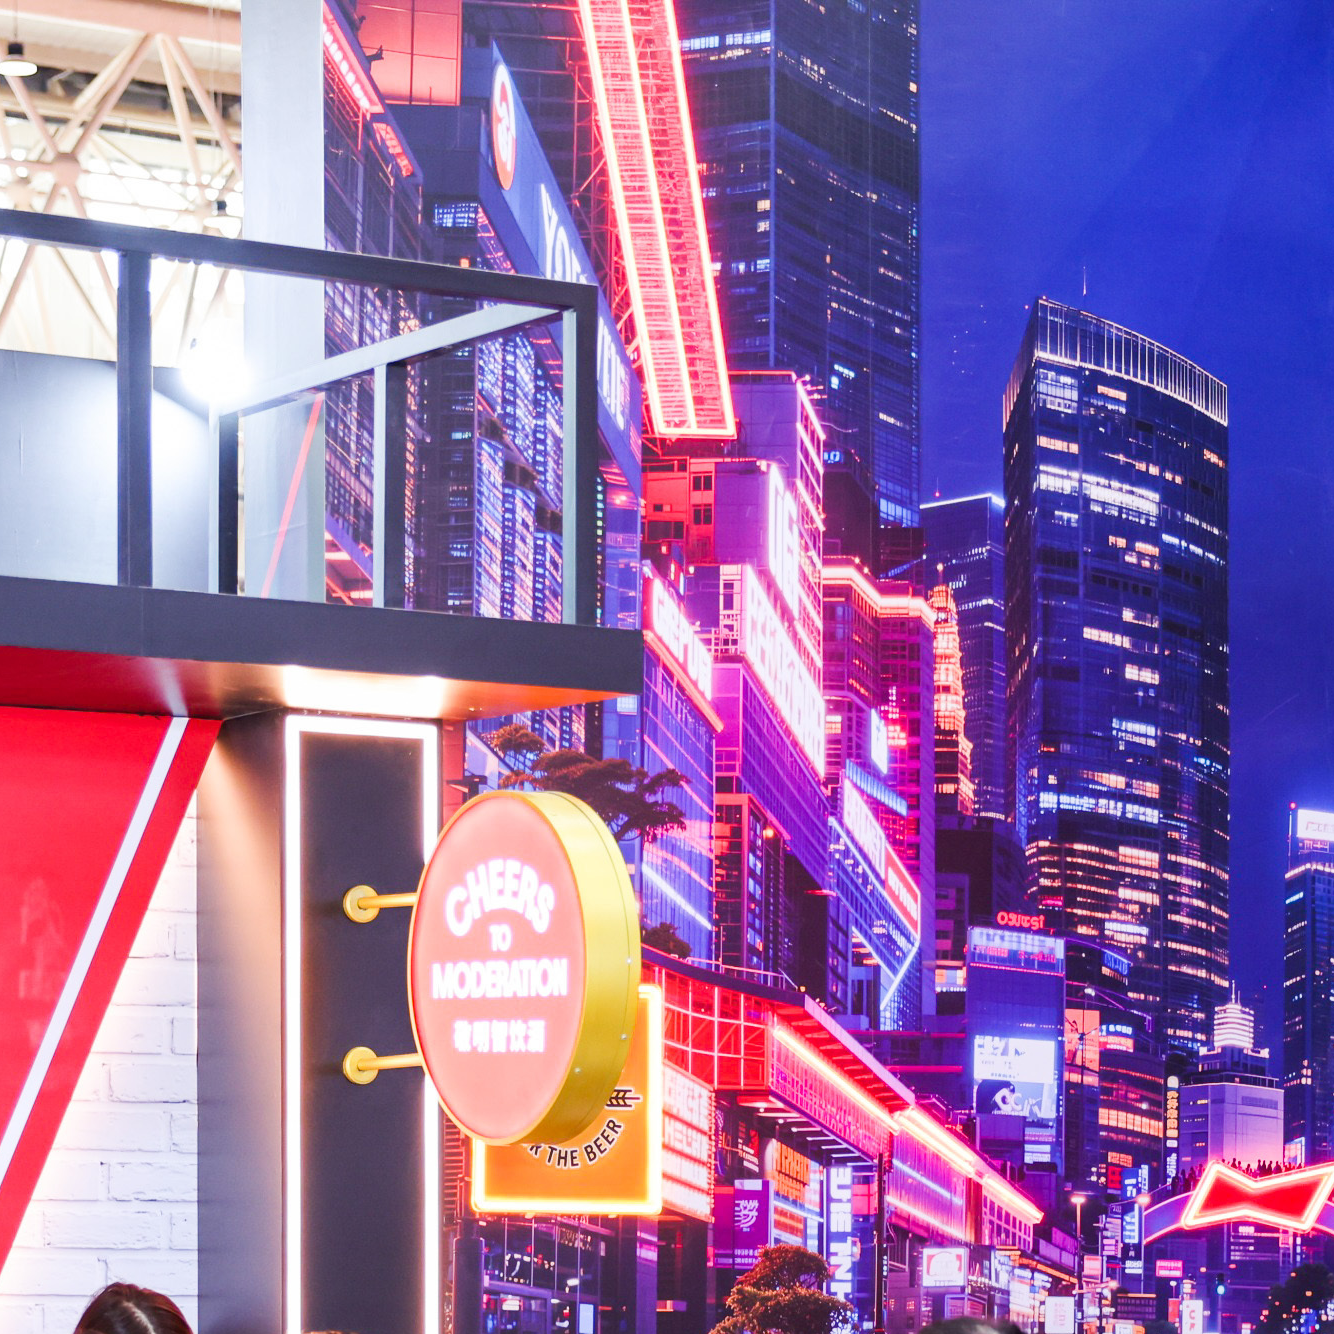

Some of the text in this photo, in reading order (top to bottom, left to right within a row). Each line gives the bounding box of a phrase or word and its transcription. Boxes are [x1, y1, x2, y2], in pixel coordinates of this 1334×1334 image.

[445, 858, 555, 938] CHEERS
[489, 922, 512, 952] TO
[431, 957, 569, 1000] MODERATION
[547, 1145, 579, 1168] THE
[584, 1118, 623, 1163] BEER
